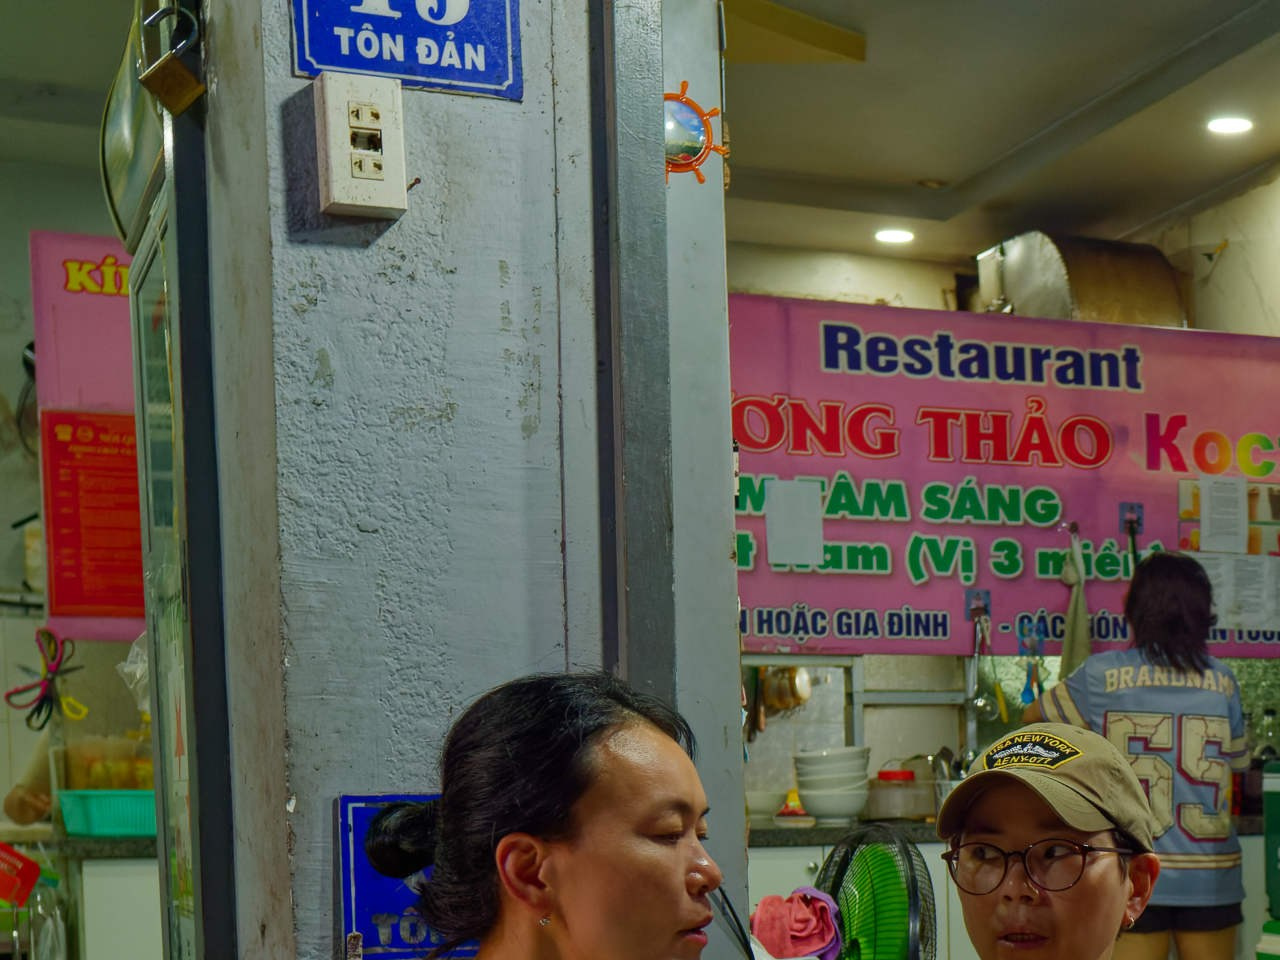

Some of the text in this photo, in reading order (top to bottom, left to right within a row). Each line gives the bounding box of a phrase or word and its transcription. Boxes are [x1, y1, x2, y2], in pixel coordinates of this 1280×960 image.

[333, 23, 486, 72] TÔN ĐẢN
[821, 321, 1142, 390] Restaurant
[731, 393, 1115, 470] ƠNG THẢO
[795, 470, 911, 521] ÂM
[920, 475, 1062, 527] SÁNG
[906, 532, 977, 585] (Vị
[990, 537, 1024, 578] 3
[754, 603, 829, 644] HOẶC
[834, 608, 881, 639] GIA
[885, 604, 951, 640] ĐÌNH
[1014, 734, 1042, 744] NEW
